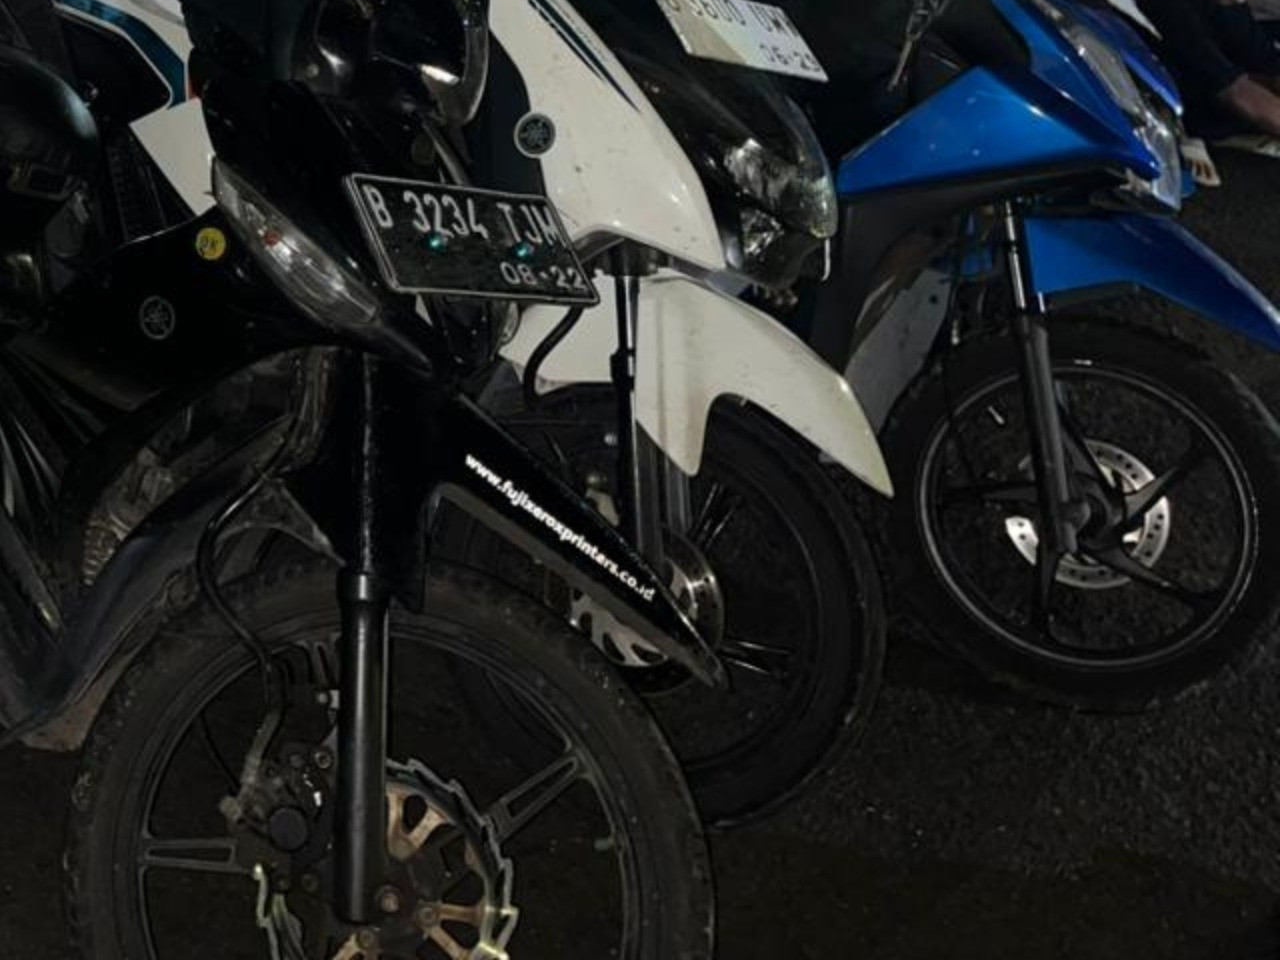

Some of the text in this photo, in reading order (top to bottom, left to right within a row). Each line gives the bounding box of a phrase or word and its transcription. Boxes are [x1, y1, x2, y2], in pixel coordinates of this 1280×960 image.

[362, 184, 394, 228] B
[403, 190, 489, 239] 3234
[465, 453, 656, 602] www.fujixeroxprinters.co.id
